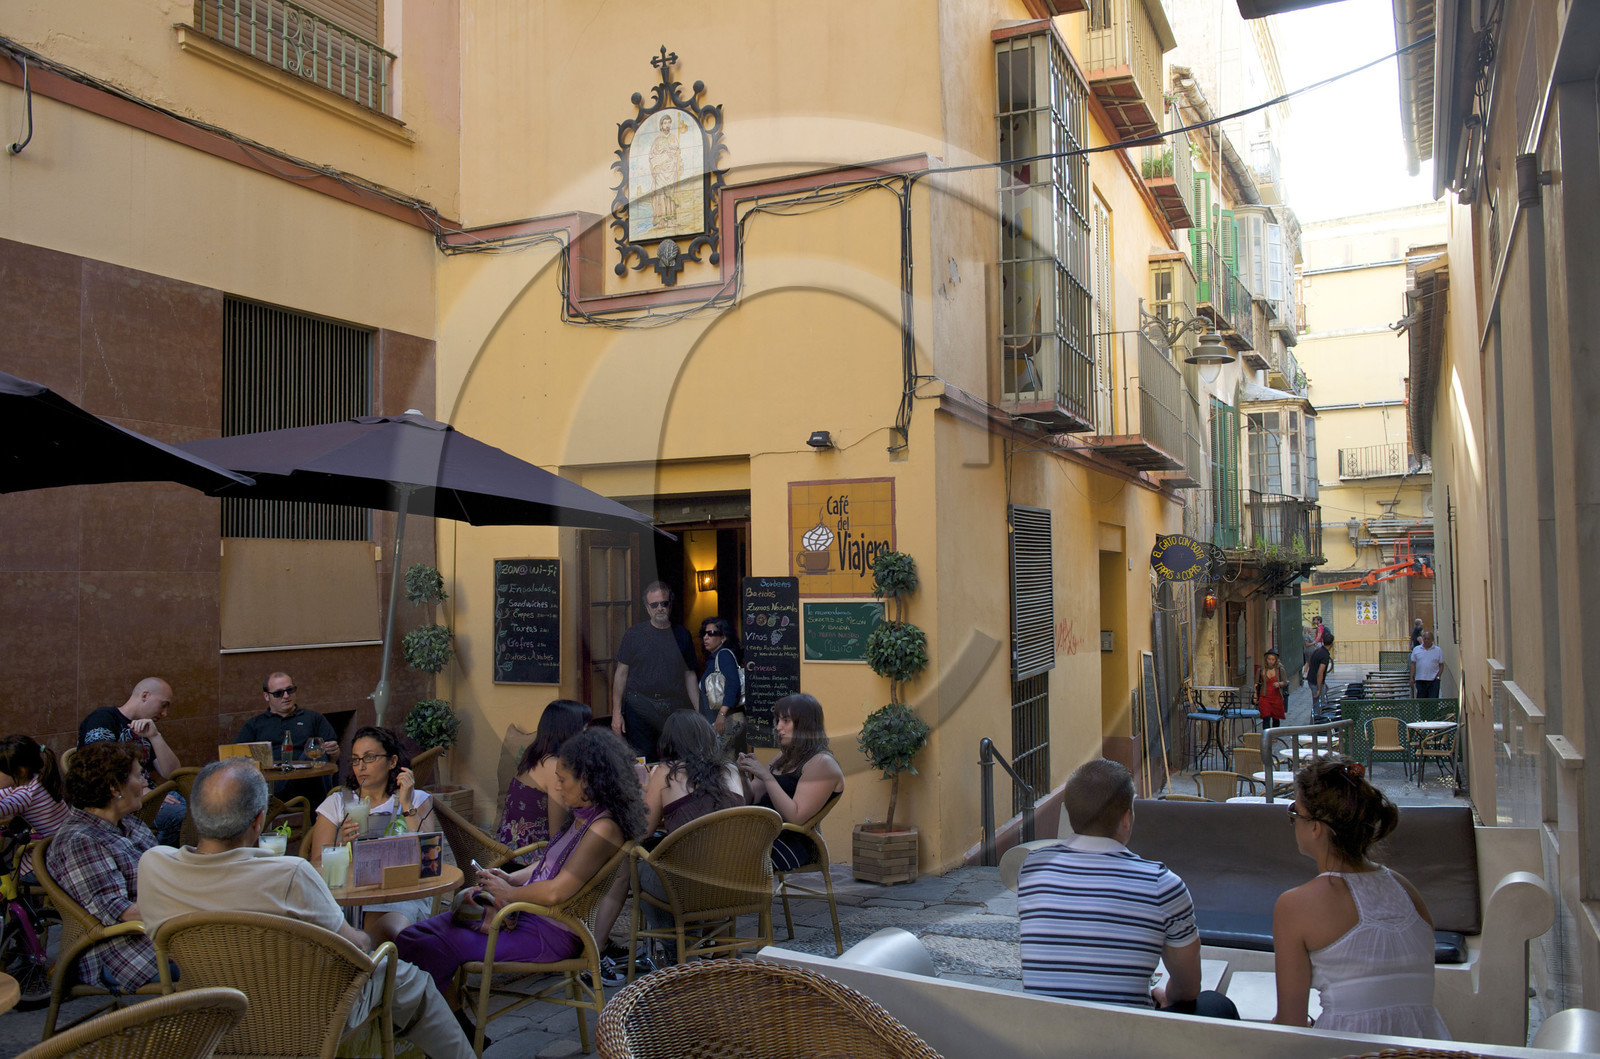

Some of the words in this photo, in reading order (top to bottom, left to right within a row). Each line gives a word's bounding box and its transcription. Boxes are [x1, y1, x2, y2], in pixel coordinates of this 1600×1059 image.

[826, 495, 849, 516] Café
[837, 516, 850, 531] del
[1158, 536, 1177, 551] GATO
[1178, 536, 1192, 547] CON
[1190, 541, 1205, 560] BOTA
[1154, 562, 1175, 580] TAPAS
[1181, 563, 1202, 581] COPAS
[508, 583, 552, 594] Ensaladas
[508, 599, 549, 608] Sandwiches
[506, 636, 534, 649] Gofres
[745, 632, 768, 641] Vinos
